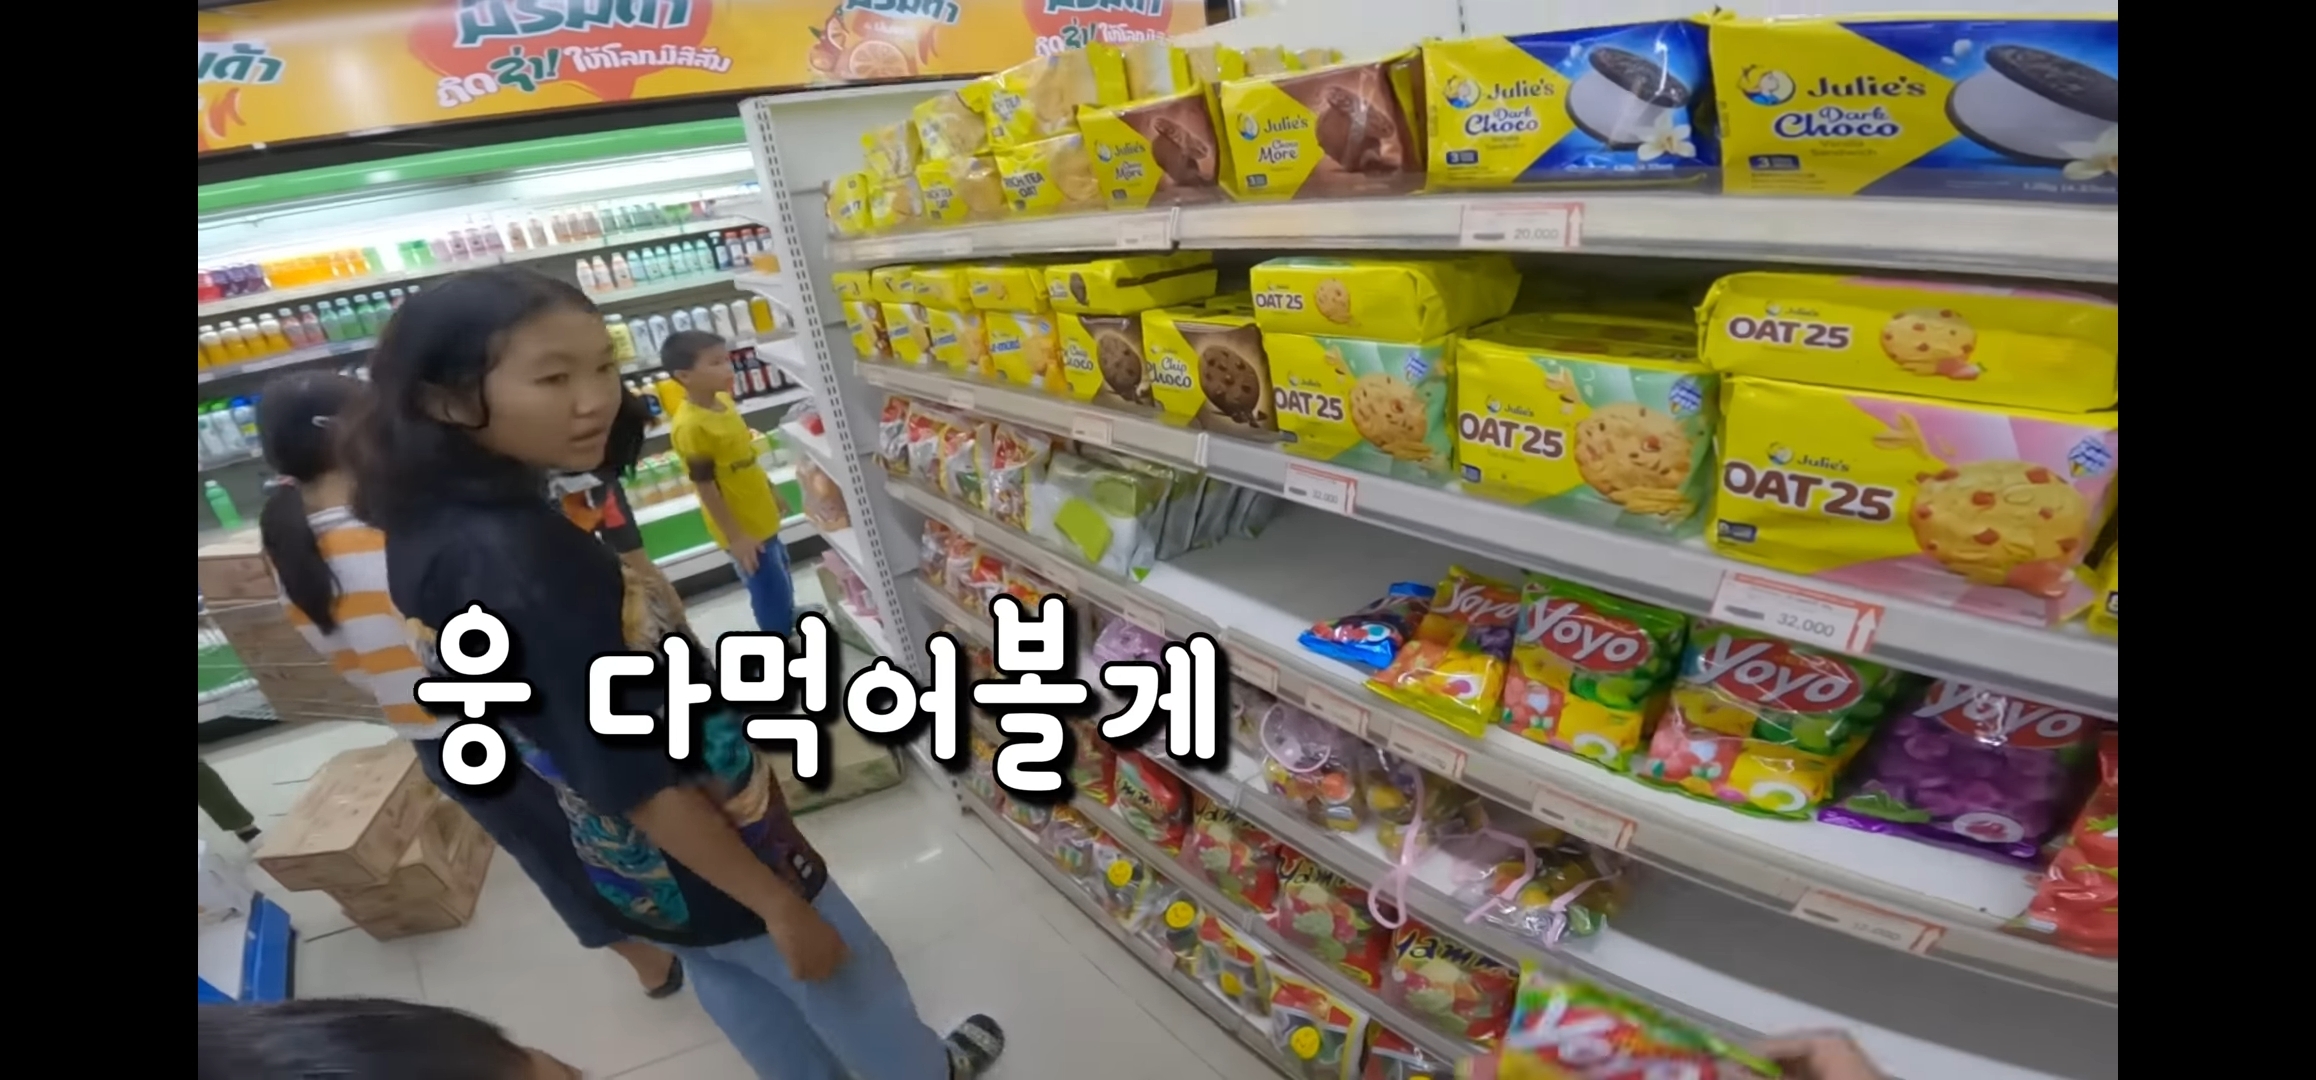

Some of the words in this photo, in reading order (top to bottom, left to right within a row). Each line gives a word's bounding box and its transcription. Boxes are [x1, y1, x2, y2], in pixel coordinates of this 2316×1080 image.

[1487, 79, 1555, 100] Julie's
[1807, 76, 1926, 98] Julie's
[1493, 106, 1532, 119] Dark
[1820, 106, 1886, 121] Dark
[1263, 116, 1309, 133] Julie's
[1464, 113, 1539, 134] Choco
[1774, 111, 1900, 137] Choco
[1114, 144, 1146, 158] Julie's
[1258, 146, 1299, 163] More
[1026, 171, 1045, 184] TEA
[1115, 167, 1143, 180] More
[1256, 293, 1284, 309] OAT
[1286, 294, 1303, 310] 25
[1728, 317, 1804, 345] OAT
[1803, 323, 1850, 350] 25
[1161, 356, 1187, 373] Chip
[1273, 387, 1312, 416] OAT
[1316, 394, 1344, 421] 25
[1460, 412, 1520, 448] OAT
[1522, 425, 1563, 458] 25
[1797, 454, 1850, 473] Julie's
[1723, 461, 1823, 509] OAT
[1823, 481, 1894, 521] 25
[1431, 577, 1521, 623] Yoyo
[1510, 596, 1640, 662] Yoyo
[1697, 633, 1850, 704] Yoyo
[1912, 679, 2082, 740] Yoyo
